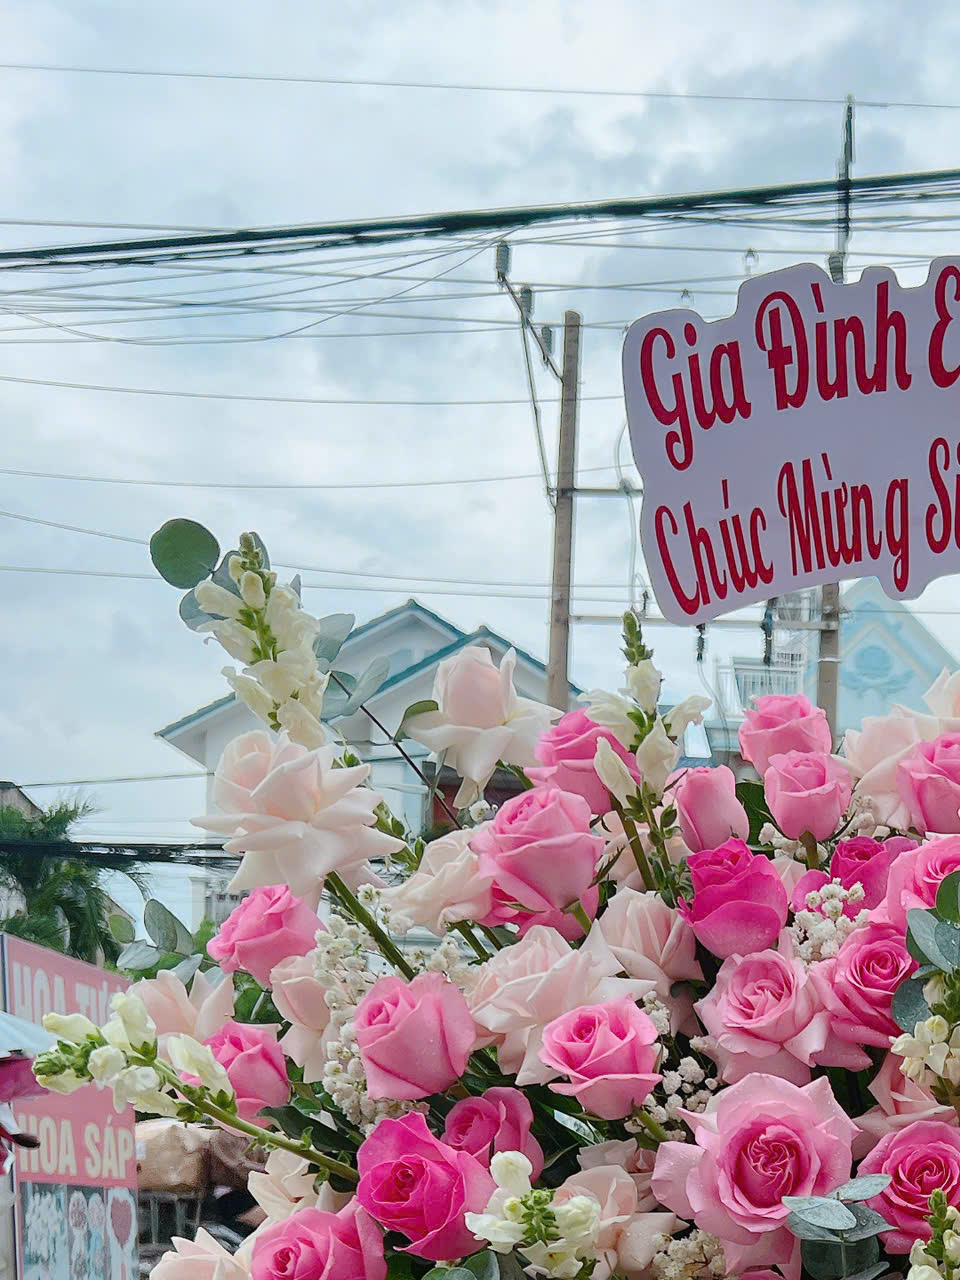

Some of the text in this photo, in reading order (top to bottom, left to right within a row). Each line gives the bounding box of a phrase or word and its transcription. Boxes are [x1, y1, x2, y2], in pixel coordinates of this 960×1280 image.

[641, 323, 752, 470] Gia
[756, 282, 912, 411] Đình
[655, 479, 774, 615] Chúc
[777, 452, 909, 592] Mừng
[18, 1112, 135, 1180] HOA SÁP
